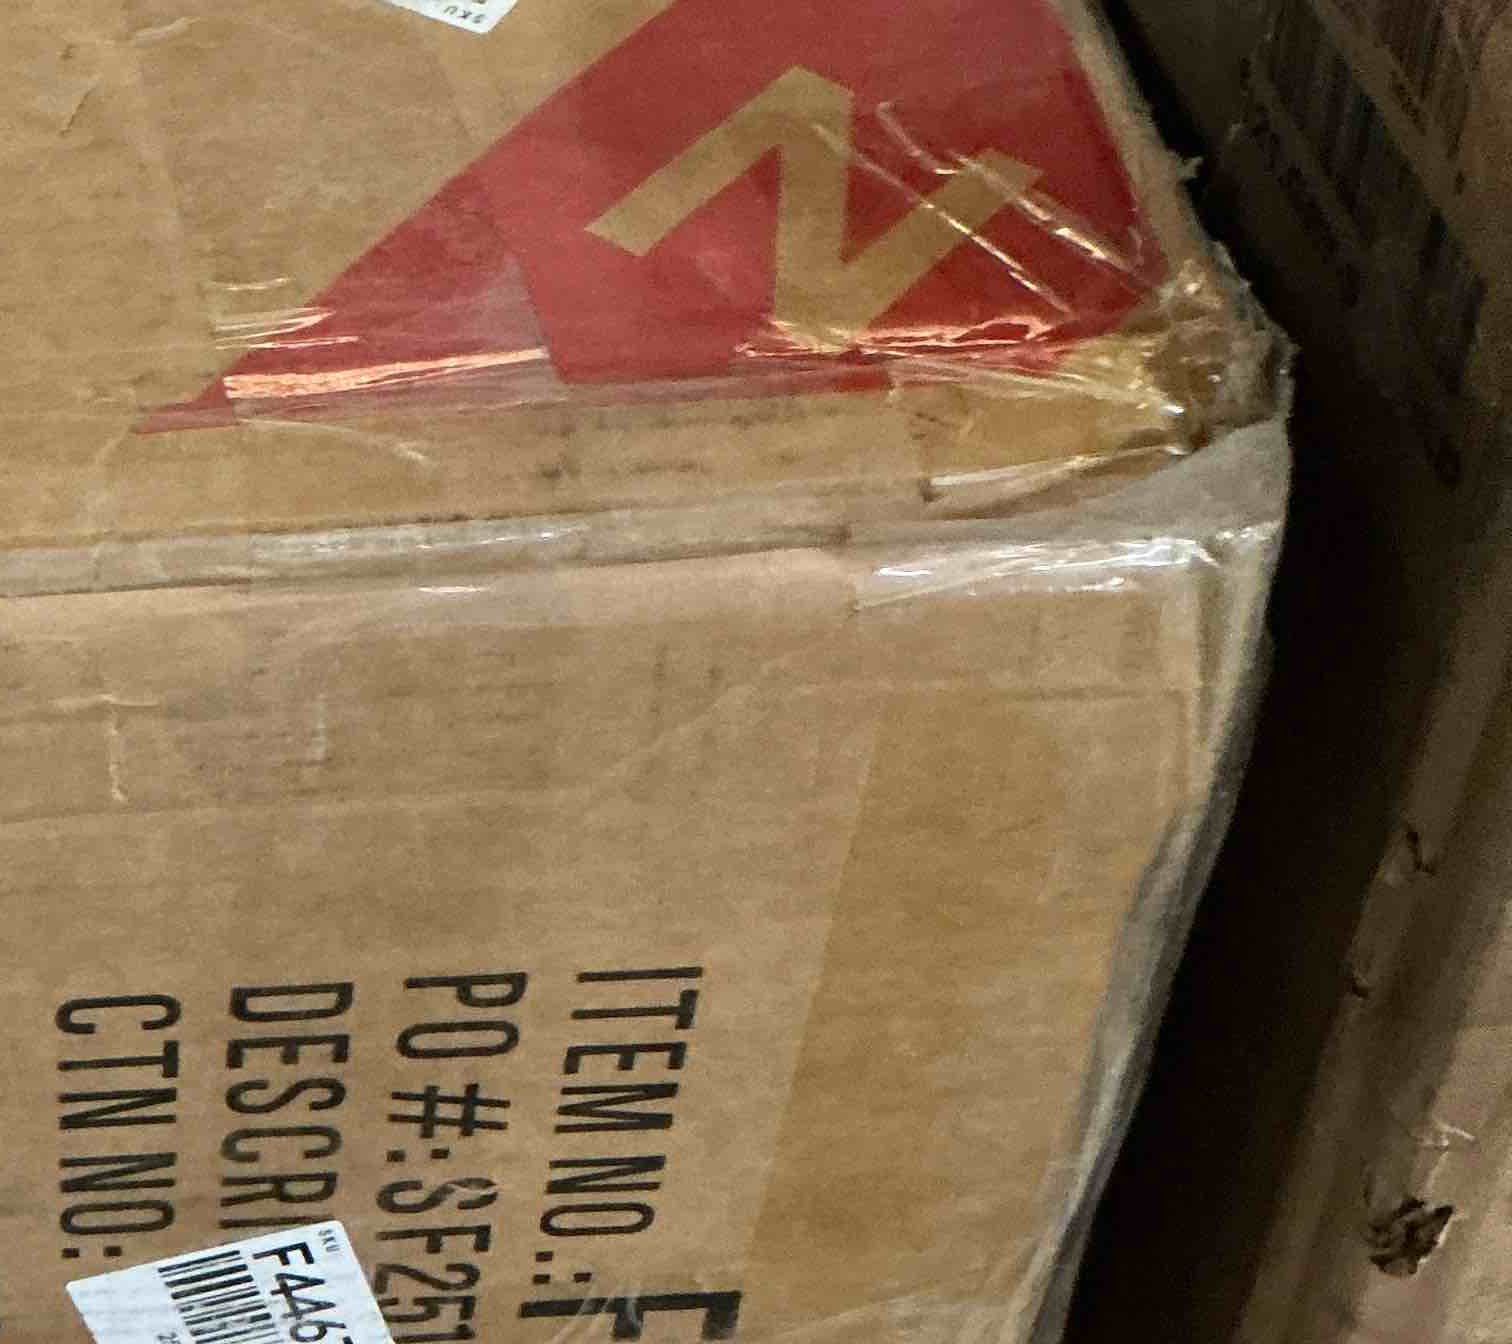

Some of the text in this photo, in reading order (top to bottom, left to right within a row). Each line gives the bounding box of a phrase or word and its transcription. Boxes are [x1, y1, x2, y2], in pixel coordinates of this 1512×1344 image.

[396, 971, 529, 1060] PO
[555, 967, 704, 1135] ITEM
[56, 993, 182, 1260] CTN NO:
